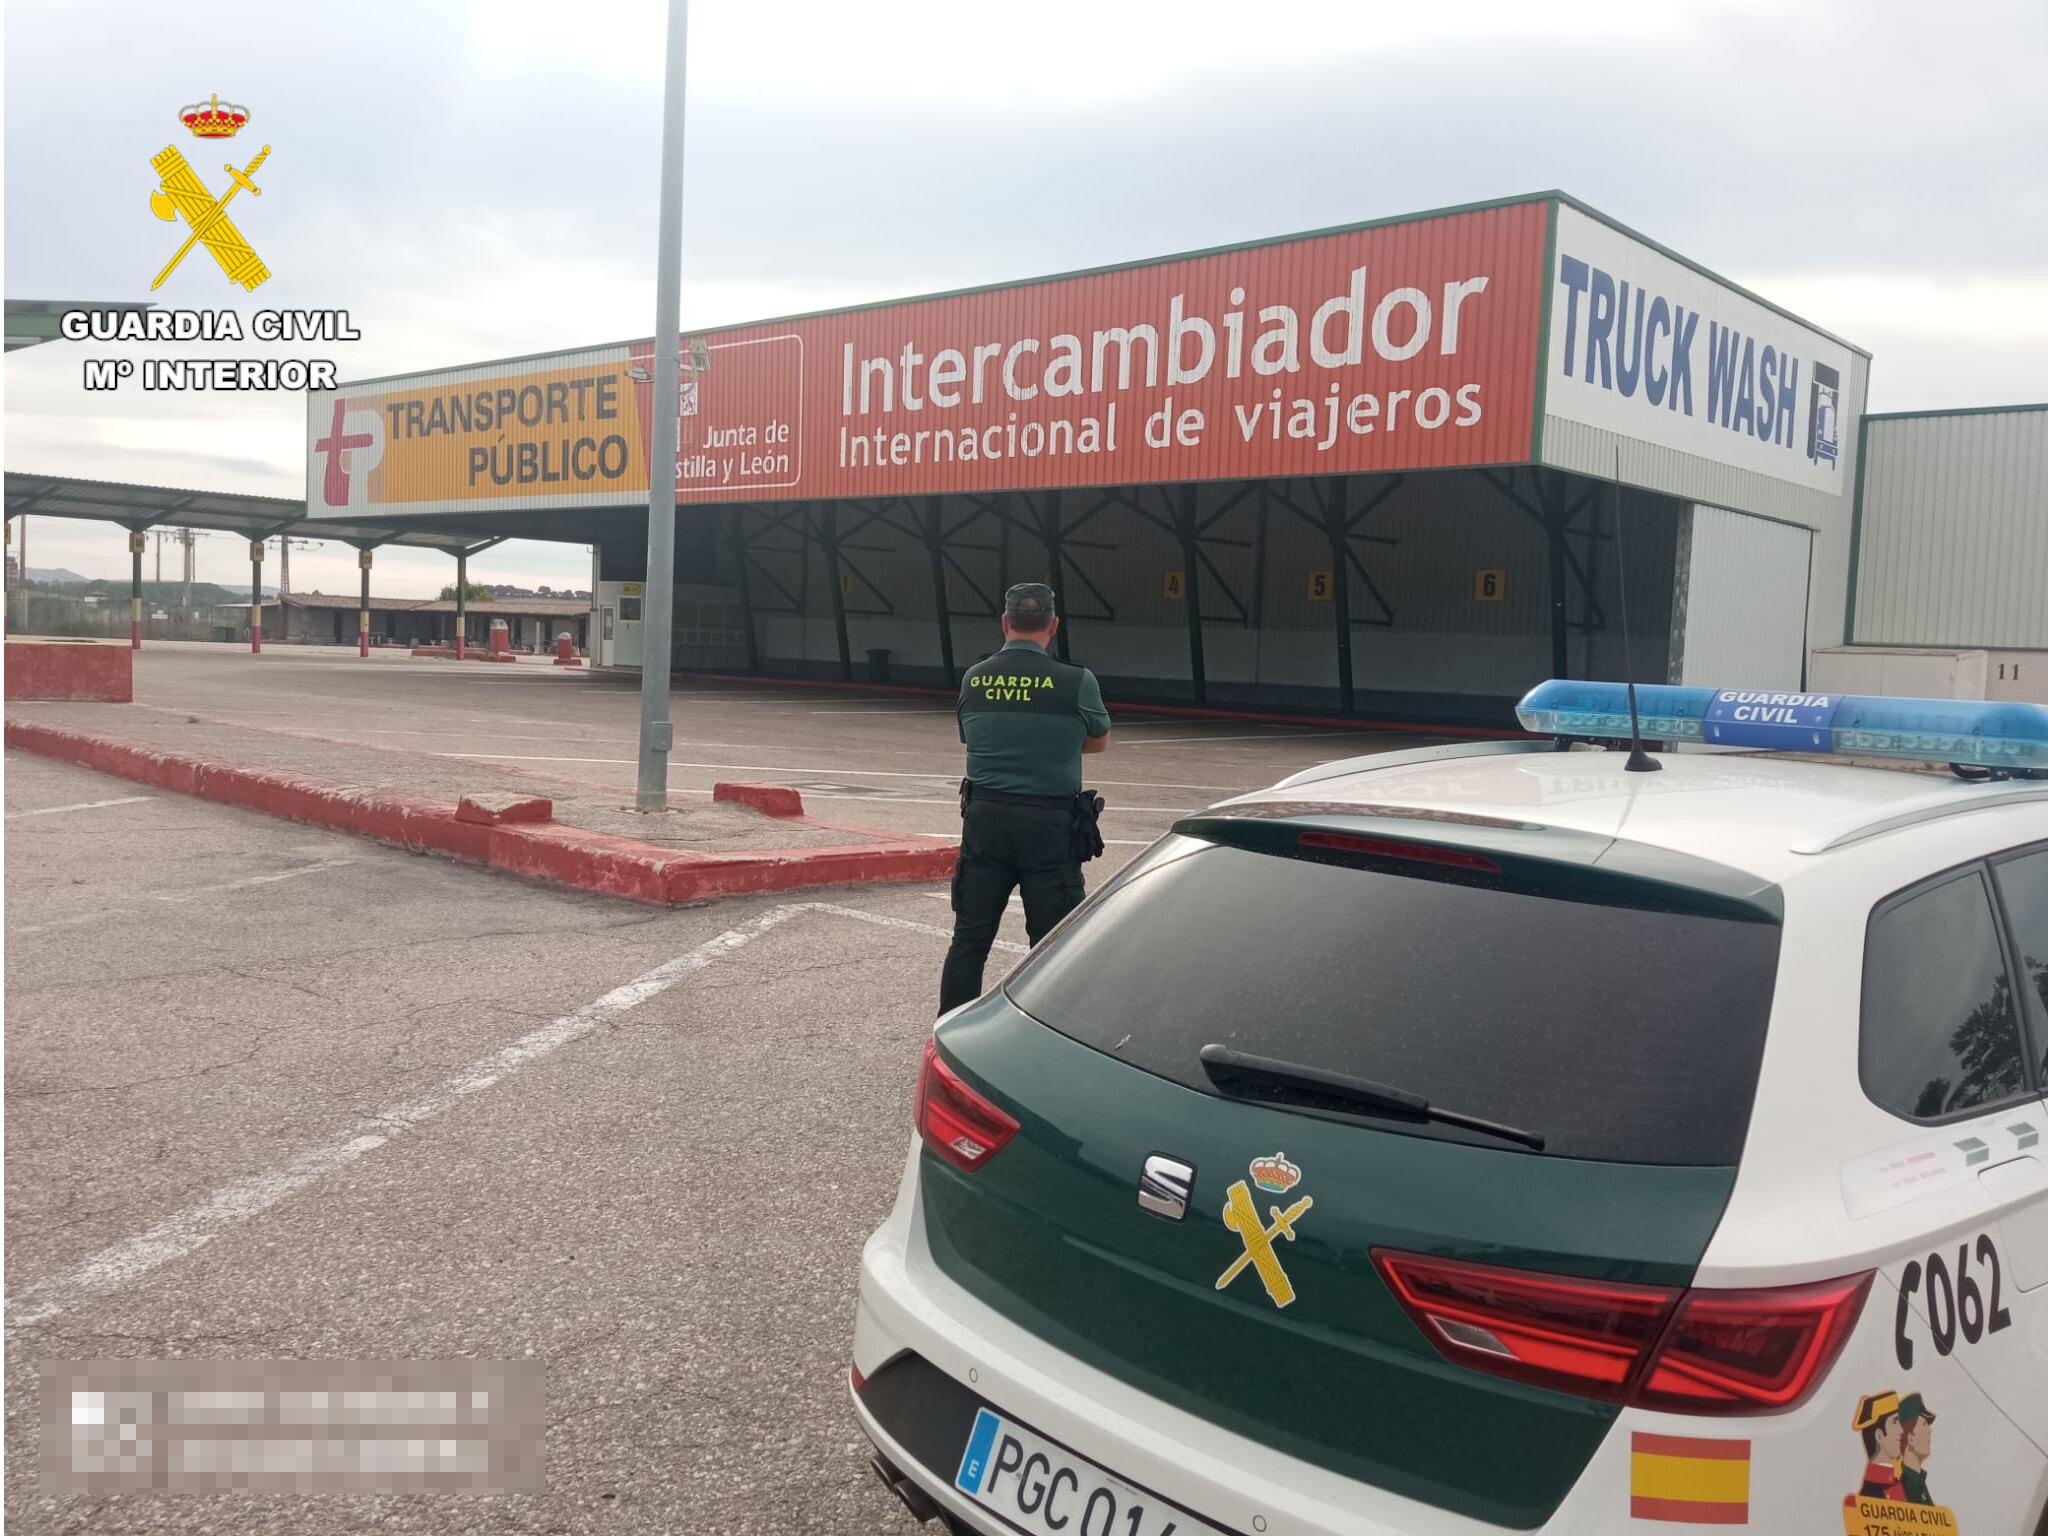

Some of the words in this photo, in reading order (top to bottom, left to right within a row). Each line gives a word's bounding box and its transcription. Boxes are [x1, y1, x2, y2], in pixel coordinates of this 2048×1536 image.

[842, 265, 1490, 416] Intercambiador
[1560, 253, 1700, 417] TRUCK
[1707, 320, 1799, 449] WASH
[387, 374, 618, 440] TRANSPORTE
[703, 424, 757, 449] Junta
[765, 419, 789, 444] de
[839, 401, 1117, 468] Internacional
[1144, 397, 1205, 449] de
[1234, 382, 1482, 451] viajeros
[468, 433, 628, 487] PÚBLICO
[676, 455, 716, 479] stilla
[722, 458, 734, 484] y
[740, 449, 789, 476] León
[1167, 575, 1180, 596] 4
[1313, 575, 1326, 597] 5
[1483, 573, 1496, 597] 6
[970, 675, 1054, 689] GUARDIA
[985, 688, 1031, 701] CIVIL
[1719, 691, 1829, 708] GUARDIA
[1734, 705, 1798, 724] CIVIL
[1926, 1233, 2012, 1357] 062
[967, 1459, 979, 1479] E
[1860, 1503, 1917, 1523] GUARDIA
[1920, 1510, 1951, 1527] CIVIL
